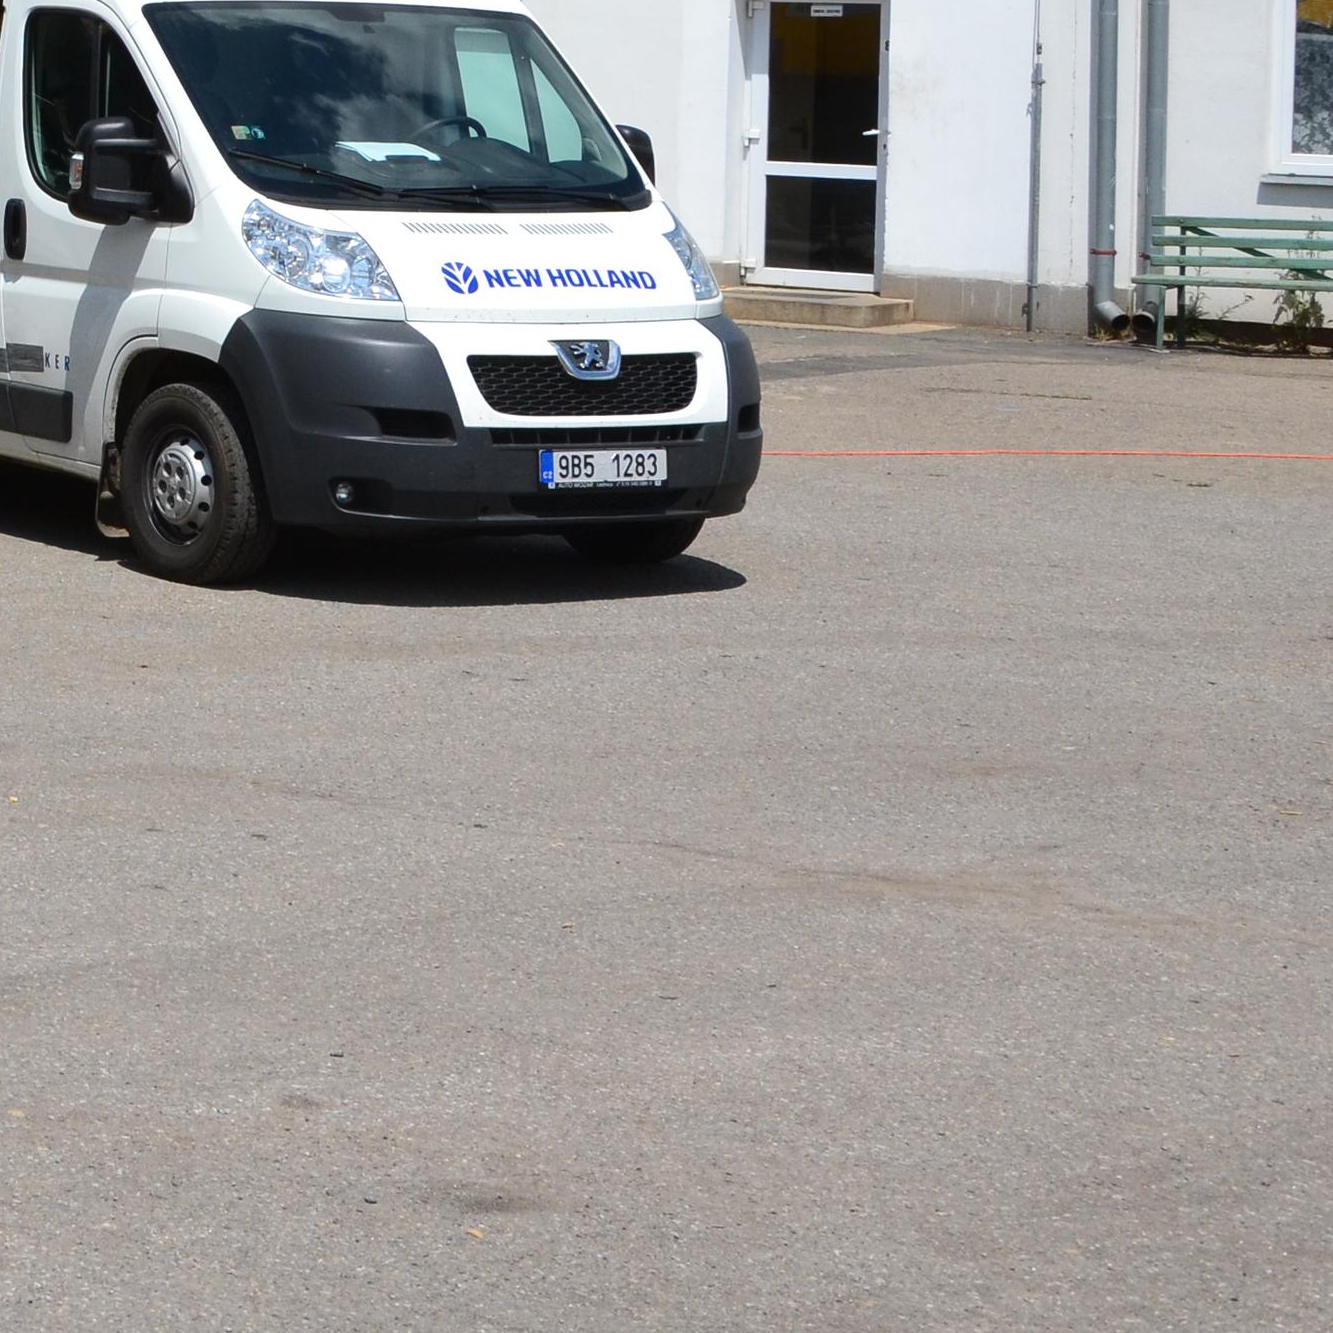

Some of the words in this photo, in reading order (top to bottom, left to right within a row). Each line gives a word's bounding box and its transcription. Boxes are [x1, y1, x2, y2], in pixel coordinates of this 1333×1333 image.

[482, 268, 543, 288] NEW
[546, 268, 657, 290] HOLLAND
[542, 470, 553, 480] CZ
[558, 454, 595, 479] 9B5
[611, 453, 658, 478] 1283
